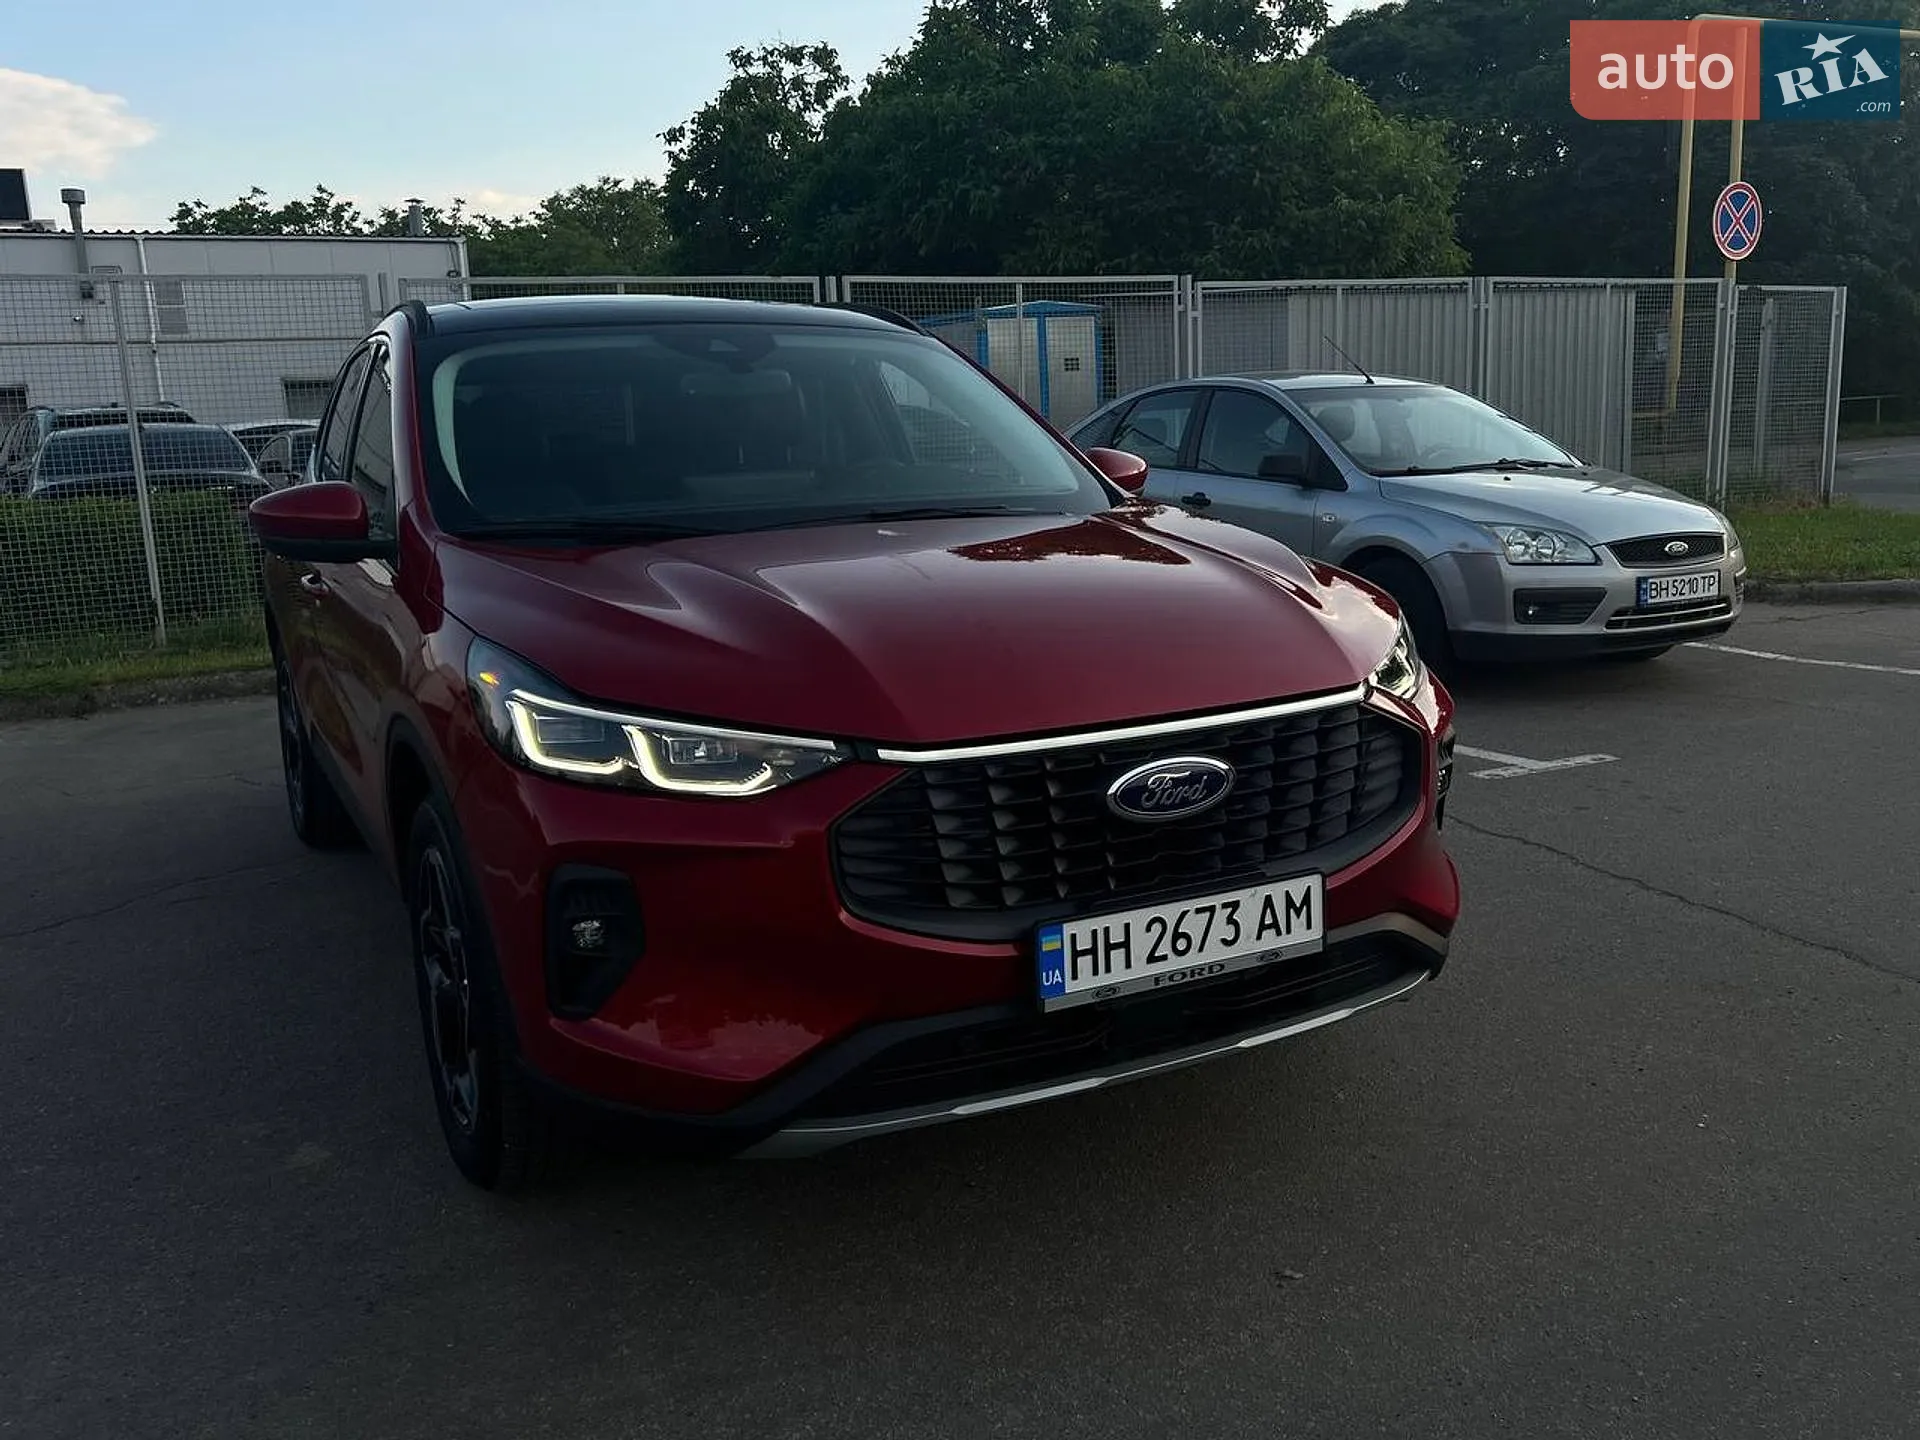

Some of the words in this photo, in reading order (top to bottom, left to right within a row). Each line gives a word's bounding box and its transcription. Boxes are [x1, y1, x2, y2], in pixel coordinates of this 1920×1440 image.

[1648, 580, 1670, 600] BH
[1671, 576, 1699, 597] 5210
[1700, 574, 1716, 594] TP
[1141, 770, 1208, 809] Ford
[1069, 921, 1132, 982] HH
[1144, 898, 1241, 965] 2673
[1255, 884, 1313, 941] AM
[1042, 967, 1063, 987] UA
[1153, 962, 1225, 987] FORD
